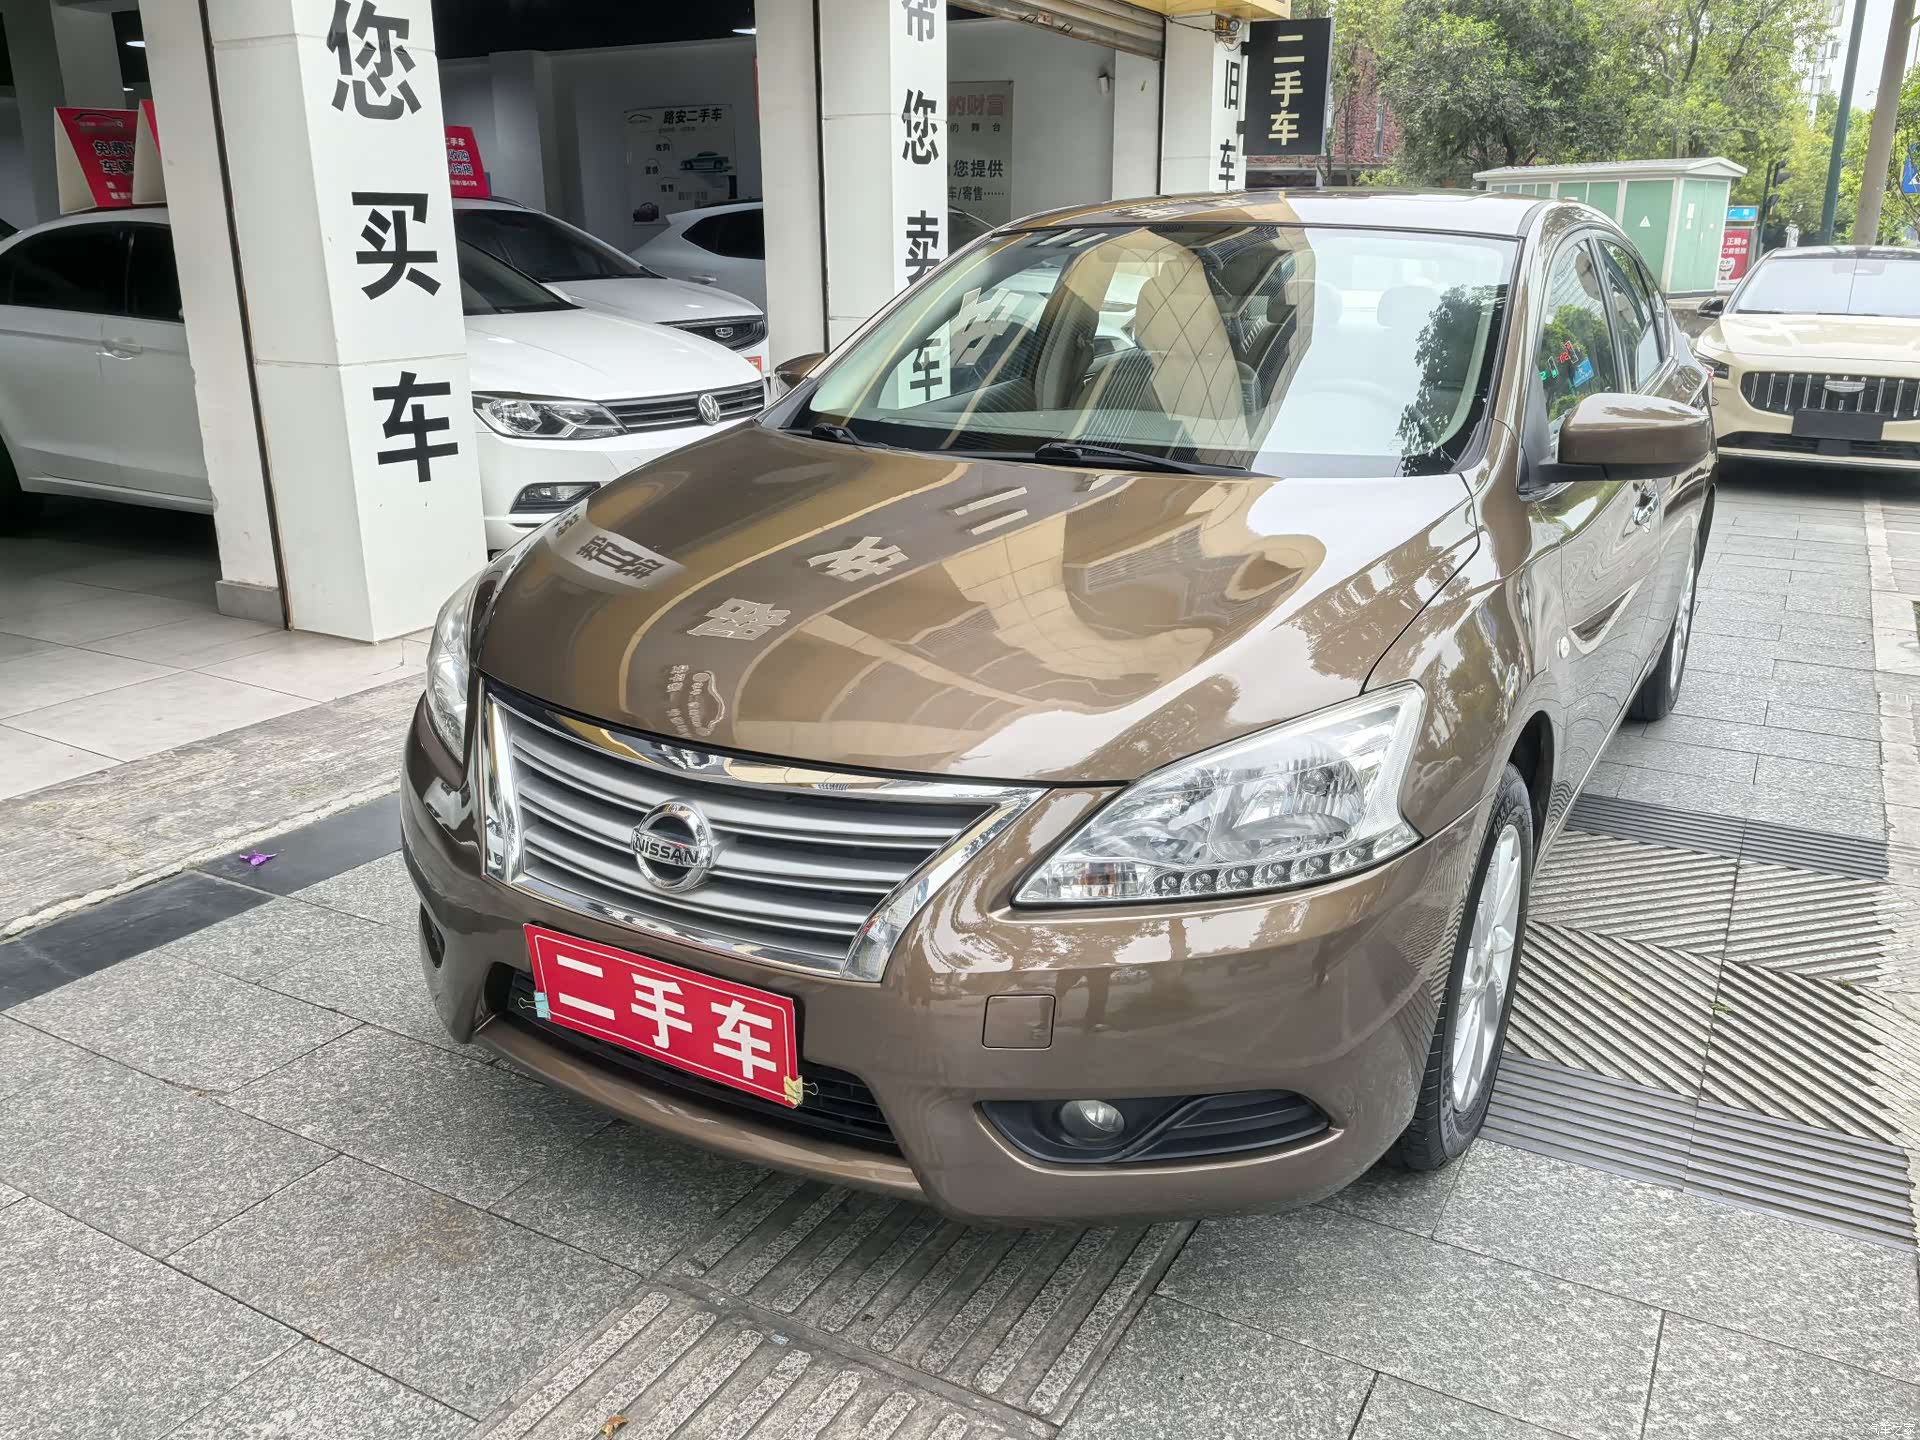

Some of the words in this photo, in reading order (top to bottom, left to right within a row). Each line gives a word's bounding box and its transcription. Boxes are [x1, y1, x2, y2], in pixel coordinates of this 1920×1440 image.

[663, 108, 723, 125] 路安二手车
[1218, 59, 1241, 191] 旧车
[1268, 34, 1305, 146] 二手车
[948, 159, 1004, 178] 您提供
[326, 0, 459, 483] 您买车
[632, 832, 699, 864] NISSAN
[556, 953, 778, 1079] 二手车
